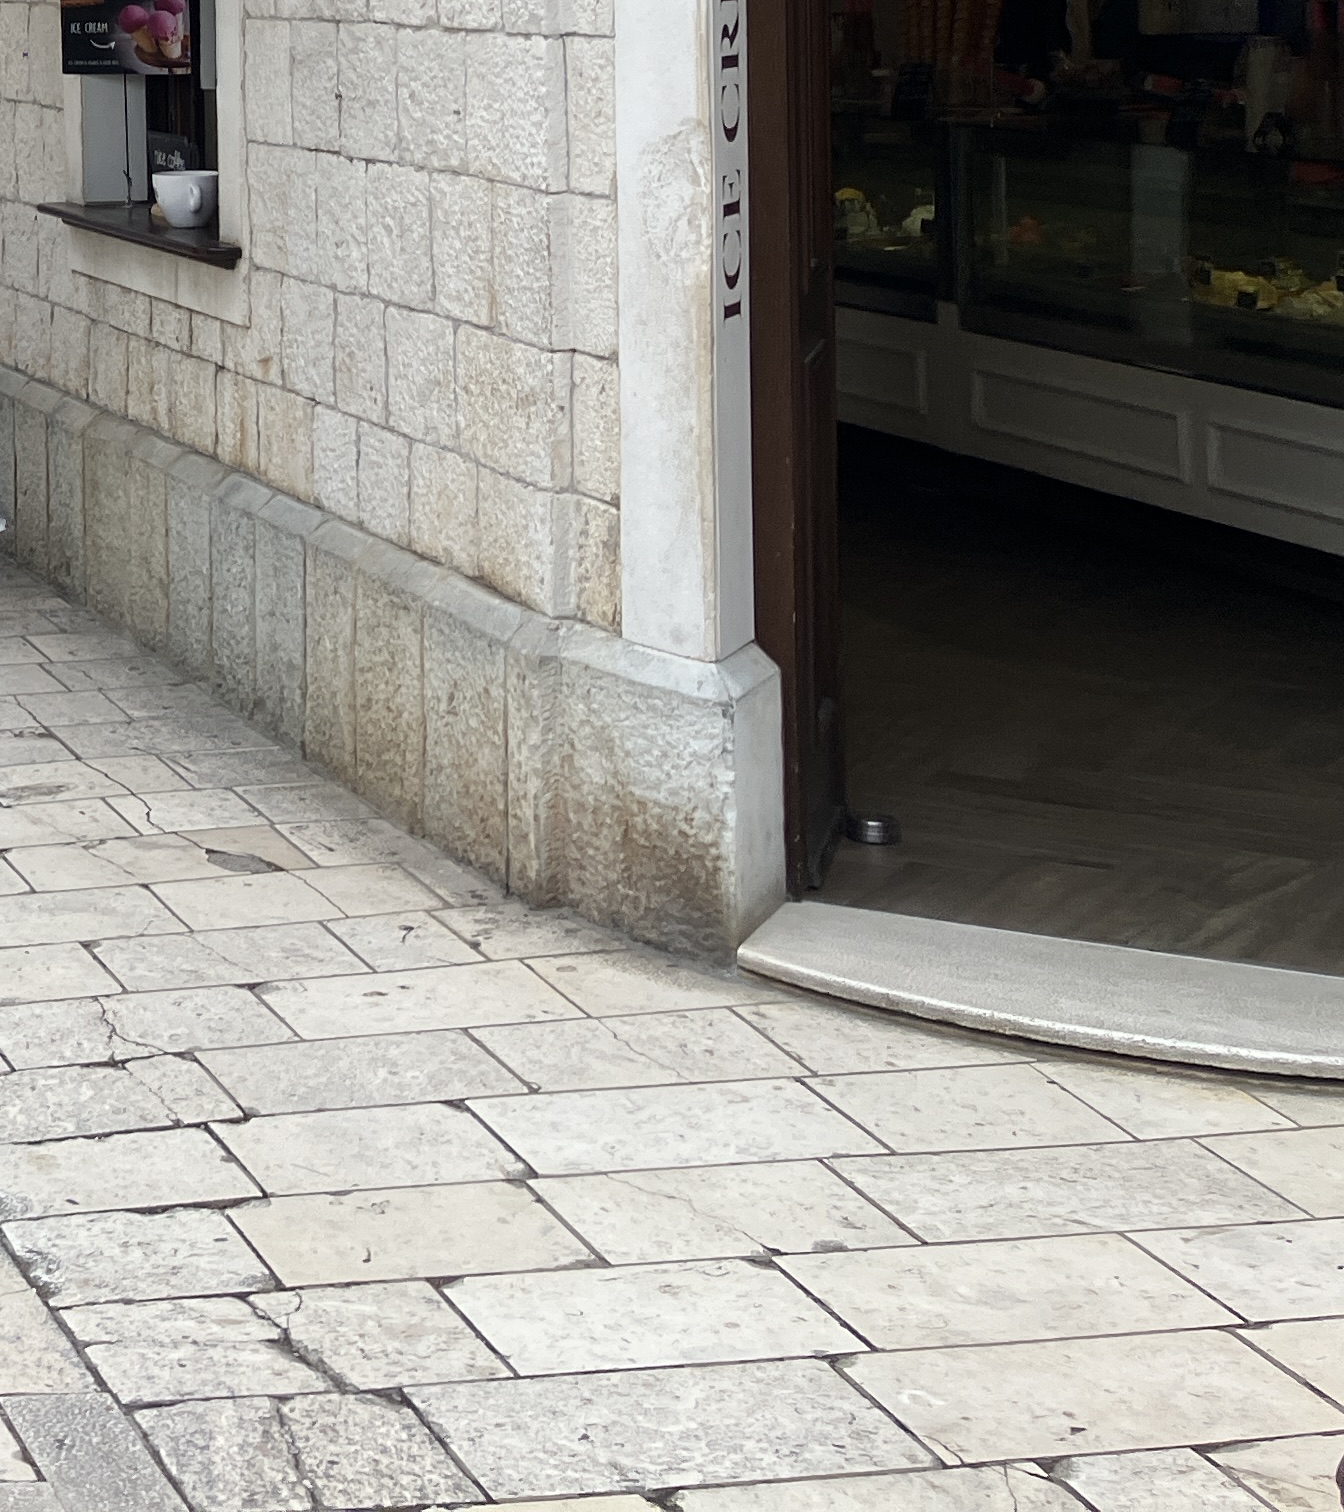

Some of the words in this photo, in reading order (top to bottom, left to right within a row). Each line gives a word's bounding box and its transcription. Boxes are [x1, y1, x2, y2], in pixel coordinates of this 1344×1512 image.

[70, 23, 82, 34] ICE
[84, 22, 108, 33] CREAM
[722, 169, 742, 322] ICE
